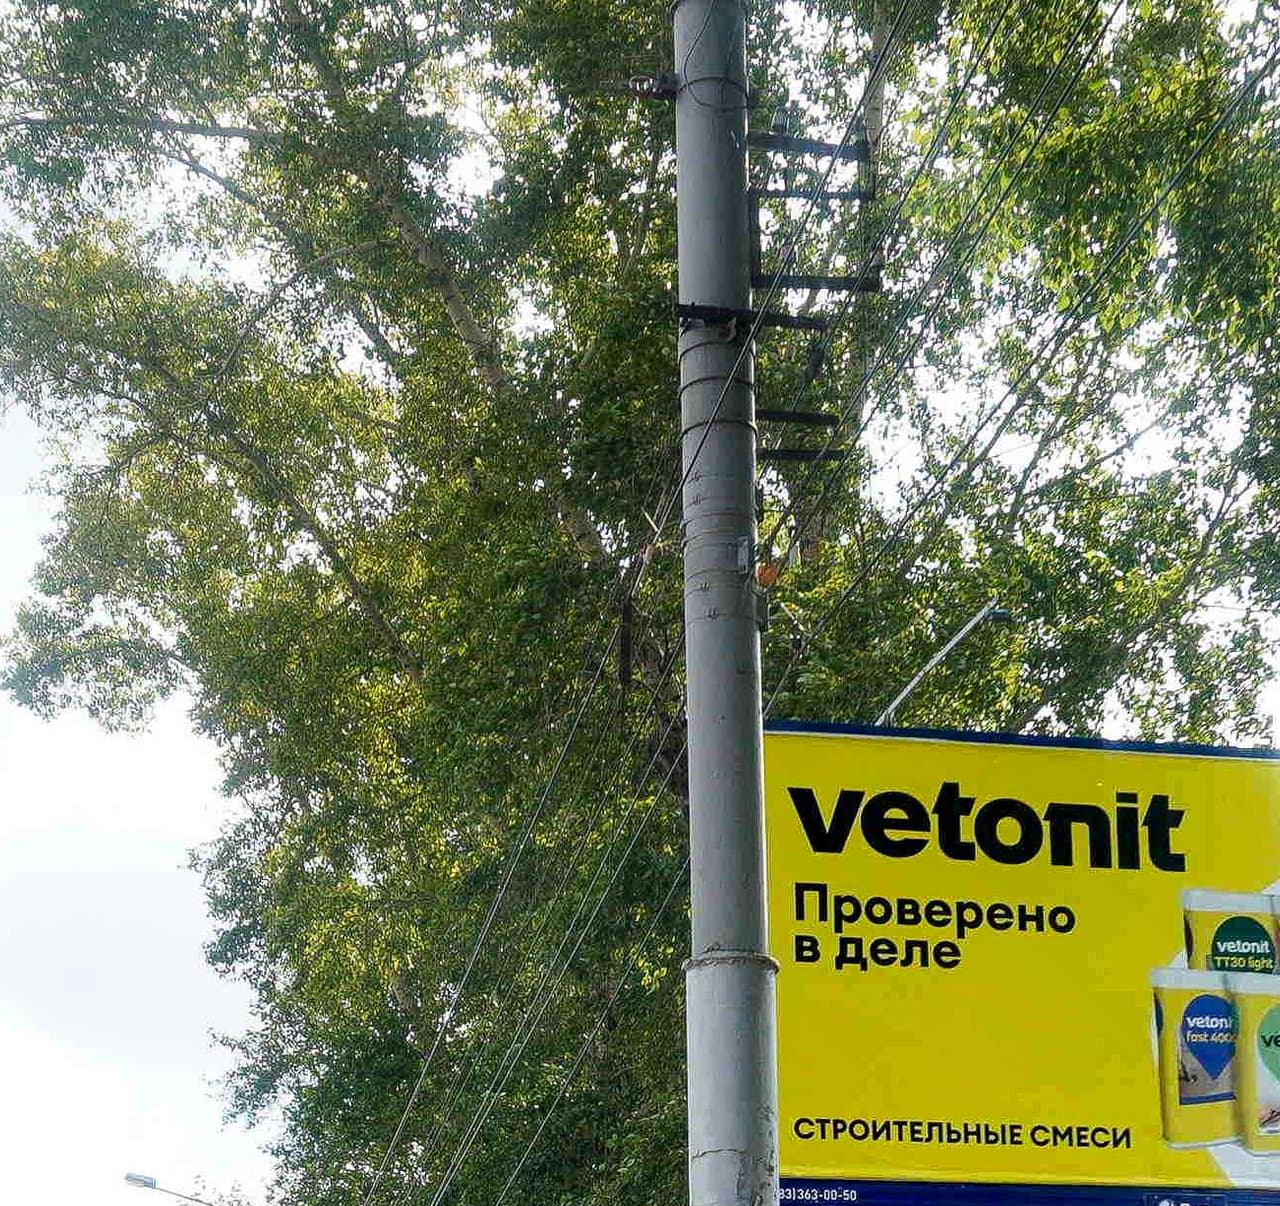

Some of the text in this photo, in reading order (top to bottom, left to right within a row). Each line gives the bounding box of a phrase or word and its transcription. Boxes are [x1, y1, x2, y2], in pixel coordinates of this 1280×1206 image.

[787, 781, 1186, 872] vetonit
[795, 882, 1076, 939] Проверено
[795, 936, 962, 972] в деле
[793, 1117, 1132, 1149] СТРОИТЕЛЬНЫЕ СМЕСИ
